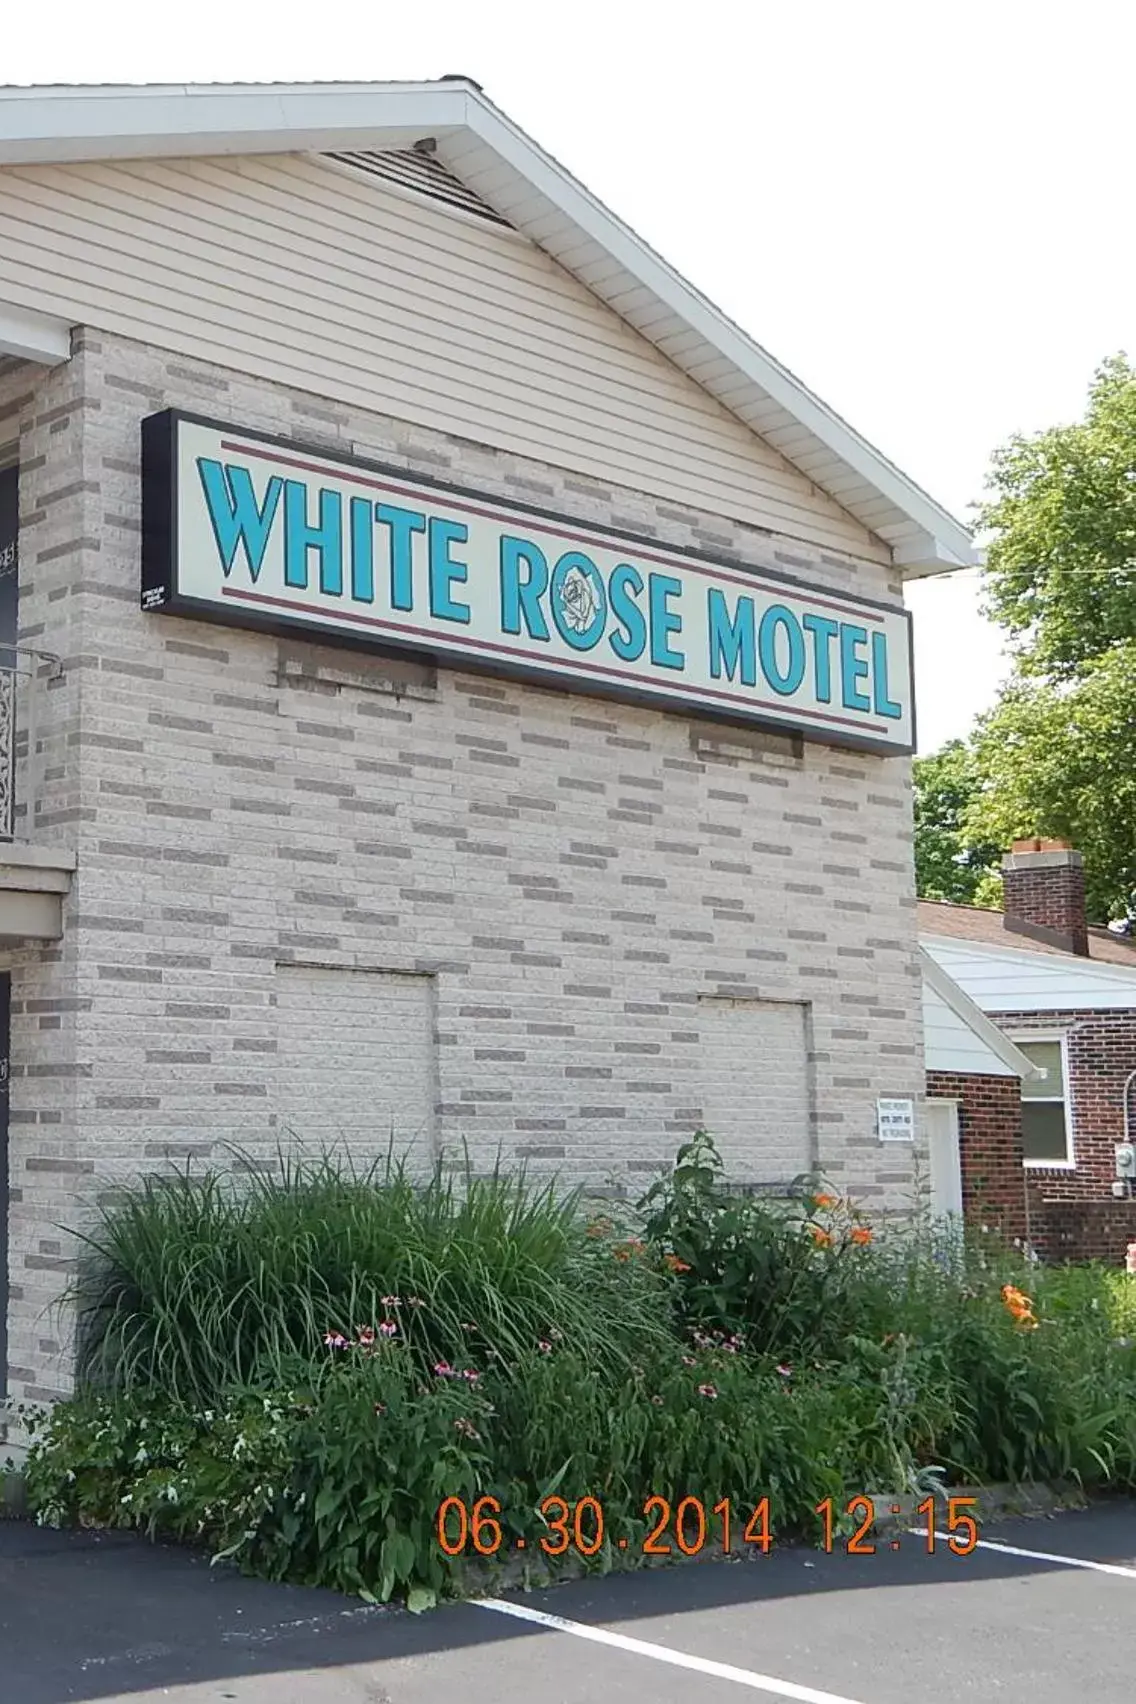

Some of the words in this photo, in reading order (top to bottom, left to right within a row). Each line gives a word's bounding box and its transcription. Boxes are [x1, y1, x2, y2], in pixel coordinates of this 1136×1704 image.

[197, 457, 471, 625] WHITE
[500, 534, 687, 671] ROSE
[707, 588, 903, 720] MOTEL
